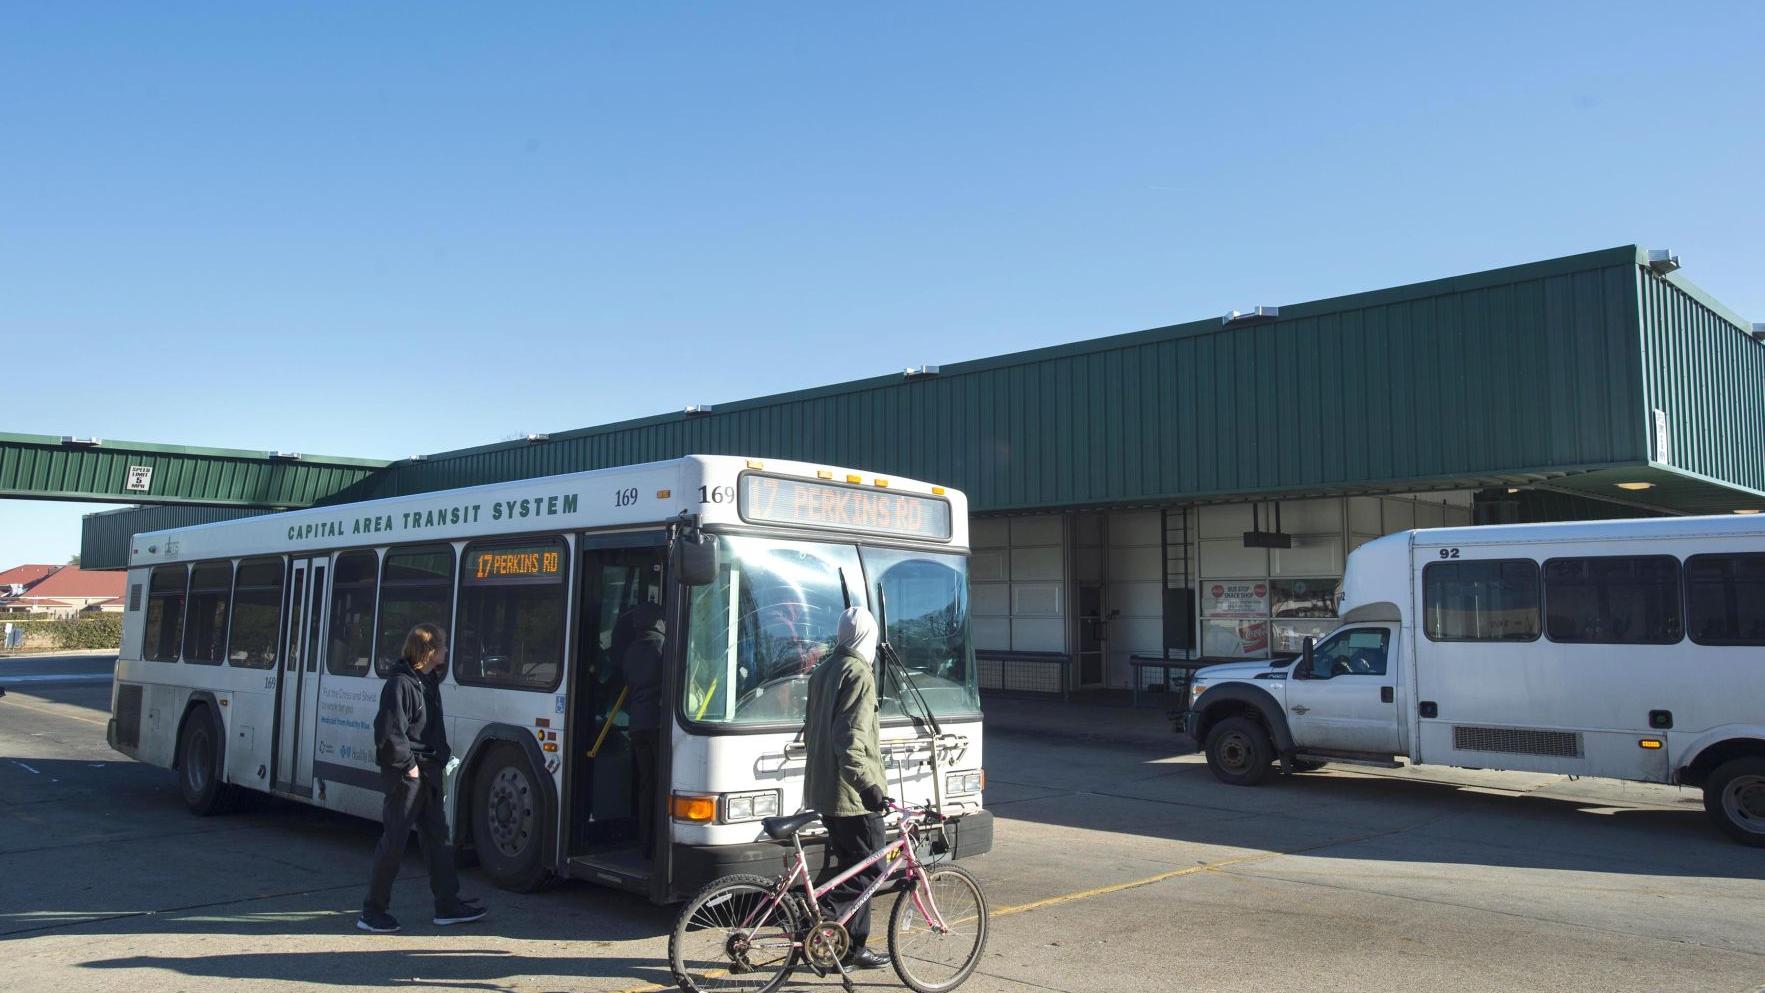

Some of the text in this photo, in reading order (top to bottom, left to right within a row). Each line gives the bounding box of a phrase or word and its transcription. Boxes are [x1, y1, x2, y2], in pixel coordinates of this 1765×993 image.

[615, 488, 638, 507] 169
[698, 485, 735, 504] 169
[753, 479, 922, 529] 17 PERKINS RD
[288, 494, 578, 540] CAPITAL AREA TRANSIT SYSTEM
[1440, 548, 1460, 559] 92
[476, 552, 558, 578] 17 PERKINS RD
[263, 676, 275, 688] 169
